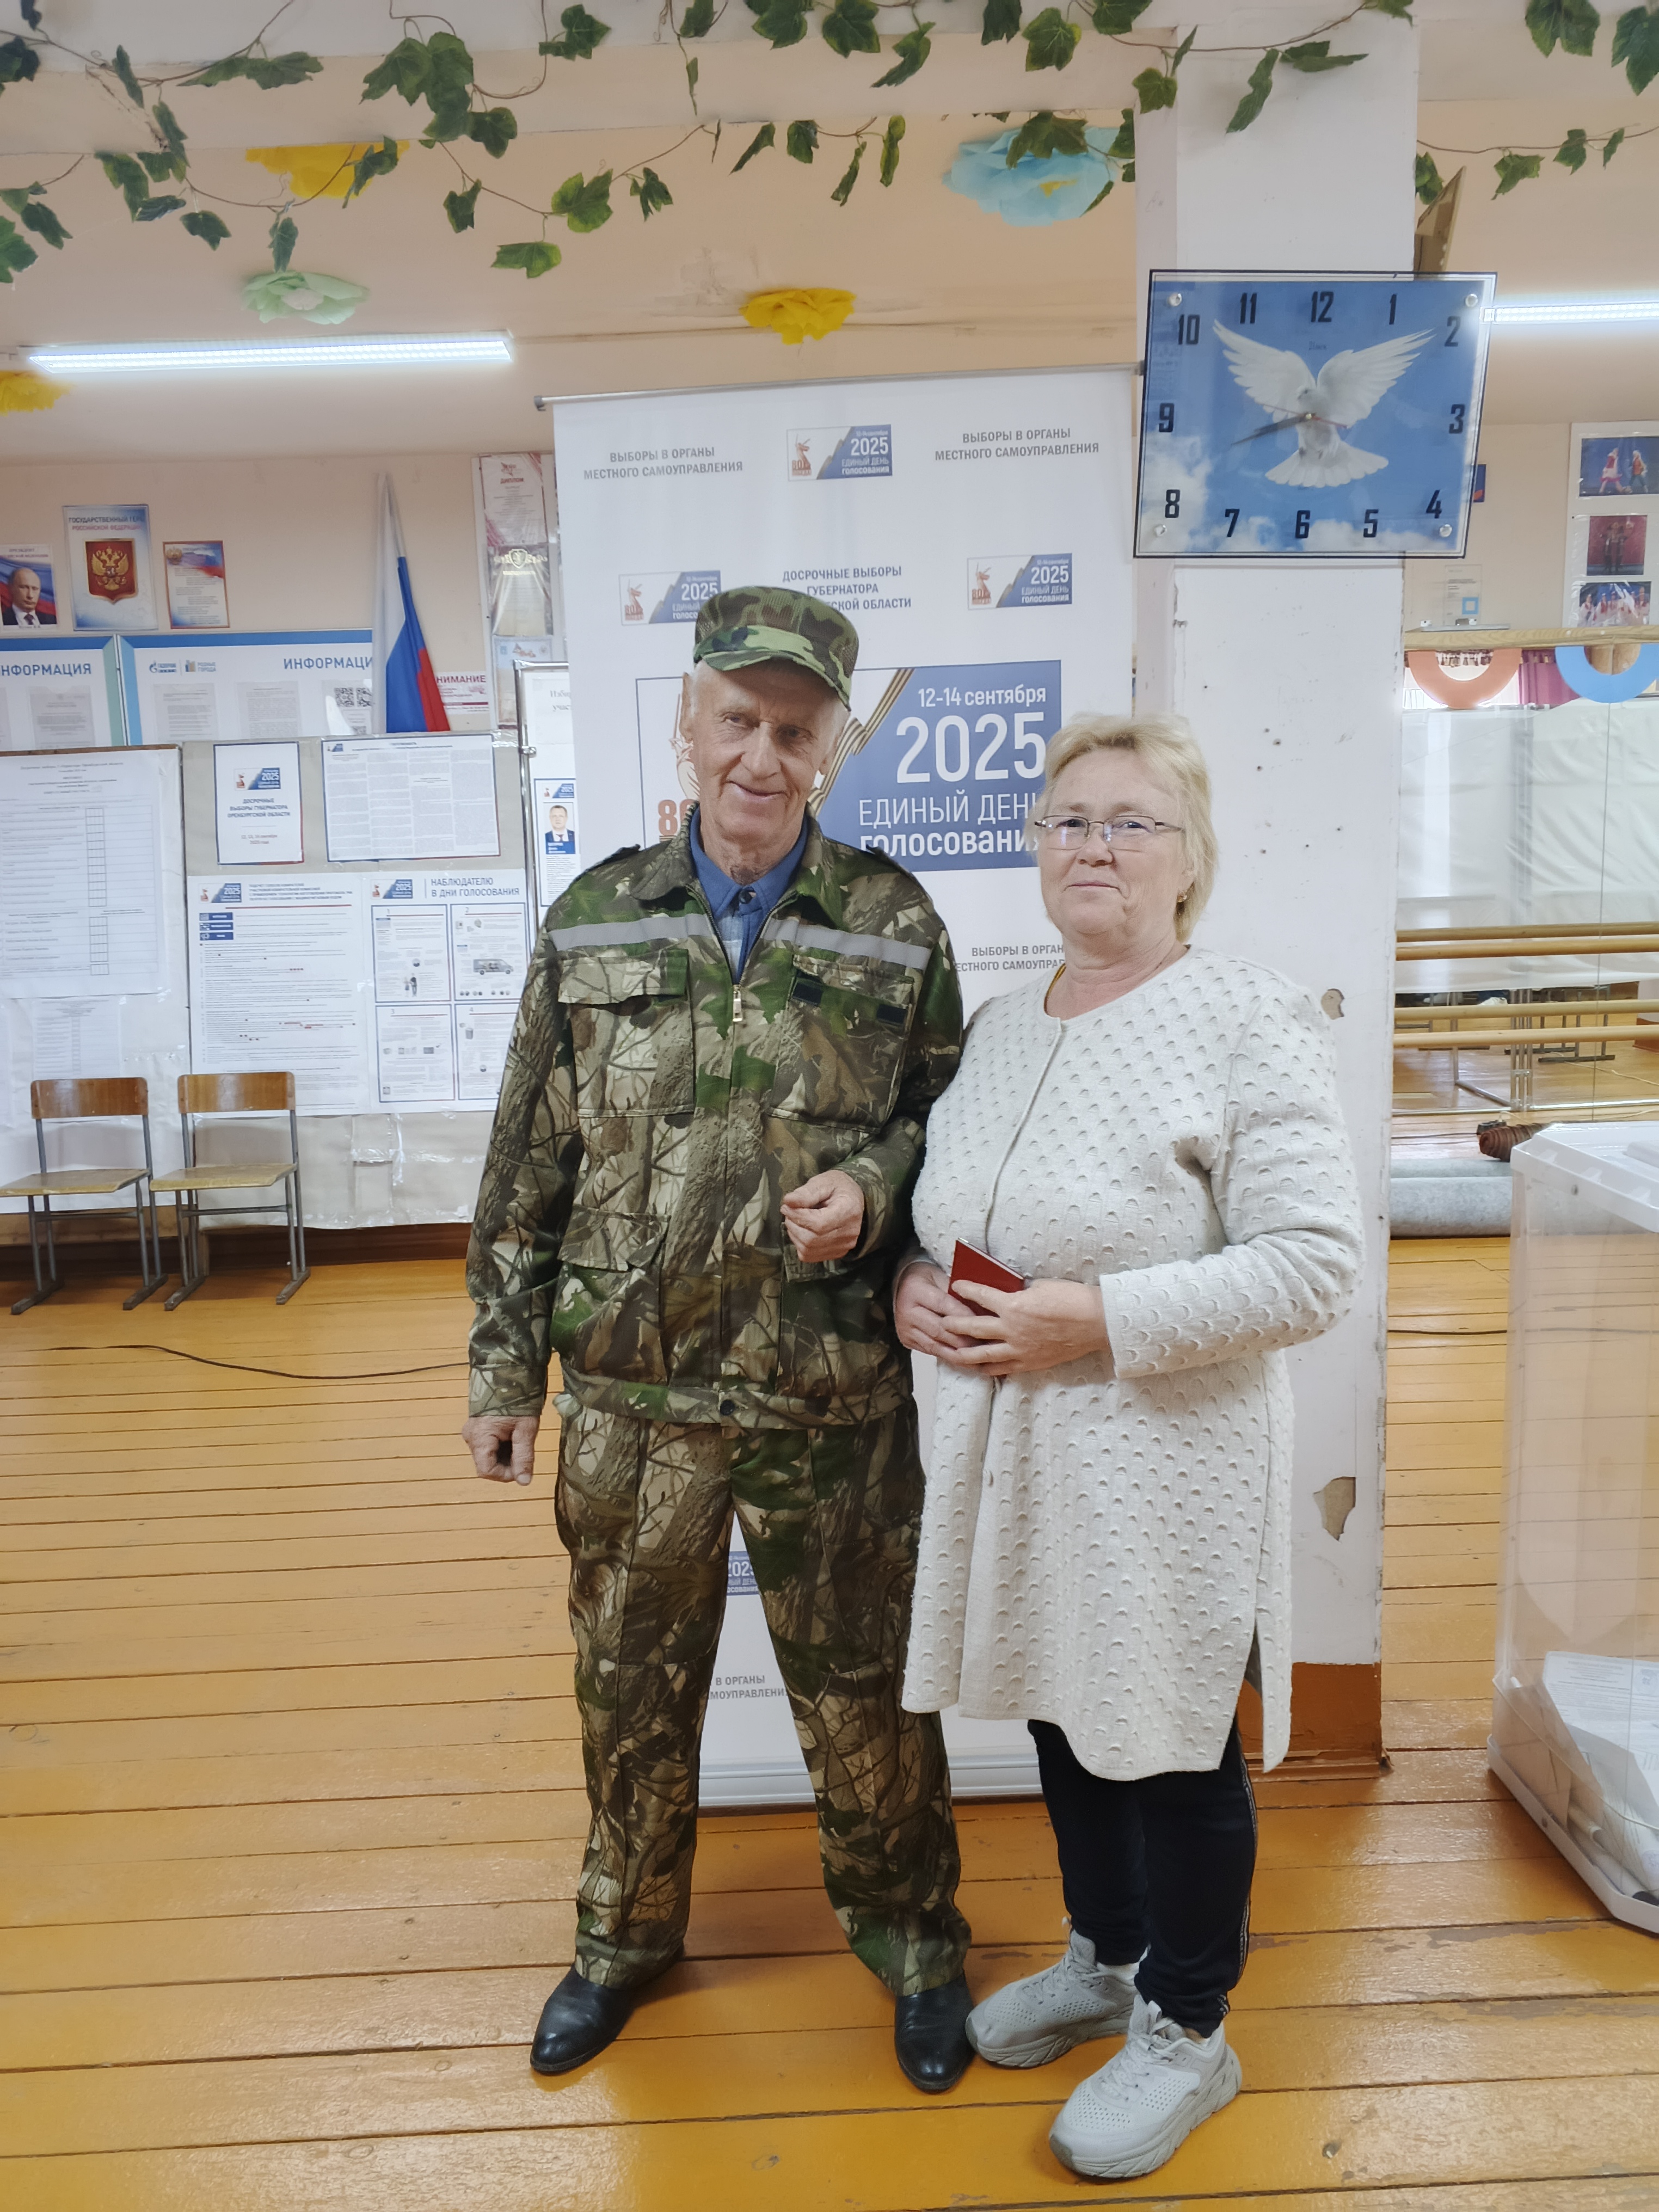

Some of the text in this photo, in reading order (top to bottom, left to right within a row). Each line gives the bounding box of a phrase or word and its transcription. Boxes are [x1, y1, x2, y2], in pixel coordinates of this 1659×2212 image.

[1239, 293, 1257, 324] 11
[1311, 291, 1334, 323] 12
[1389, 293, 1397, 325] 1
[1178, 314, 1200, 345] 10
[1445, 316, 1461, 347] 2
[1159, 403, 1175, 433] 9
[1449, 404, 1465, 434] 3
[963, 428, 1071, 443] ВЫБОРЫ В ОРГАНЫ
[610, 447, 715, 462] ВЫБОРЫ В ОРГАНЫ
[851, 437, 889, 456] 2025
[935, 443, 1099, 460] МЕСТНОГО САМОУПРАВЛЕНИЯ
[842, 456, 889, 466] ЕДИНЫЙ ДЕНЬ
[583, 462, 742, 480] МЕСТНОГО САМОУПРАВЛЕНИЯ
[842, 466, 889, 475] голосования
[1165, 489, 1180, 518] 8
[1426, 490, 1442, 519] 4
[1225, 509, 1240, 537] 7
[1295, 510, 1311, 538] 6
[1363, 509, 1379, 537] 5
[782, 566, 901, 582] ДОСРОЧНЫЕ ВЫБОРЫ
[1031, 566, 1069, 585] 2025
[681, 582, 718, 600] 2025
[807, 583, 878, 595] ГУБЕРНАТОРА
[1022, 586, 1068, 595] ЕДИНЫЙ ДЕНЬ
[863, 598, 911, 610] ОБЛАСТИ
[1022, 594, 1069, 603] голосования
[1, 663, 91, 677] НФОРМАЦИЯ
[284, 656, 372, 670] ИНФОРМАЦИ
[436, 675, 486, 683] НИМАНИЕ
[918, 684, 1046, 707] 12-14 сентября
[896, 712, 1046, 783] 2025
[859, 789, 969, 829] ЕДИНЫЙ
[861, 830, 1038, 857] голосовани
[431, 877, 493, 886] НАБЛЮДАТЕЛЮ
[440, 889, 457, 898] ДНИ
[459, 888, 520, 897] ГОЛОСОВАНИЯ
[972, 944, 1064, 956] ВЫБОРЫ В ОРГАН
[956, 961, 999, 972] ЕСТНОГО
[716, 1675, 765, 1686] В ОРГАНЫ
[709, 1688, 788, 1700] МОУПРАВЛЕНИ
